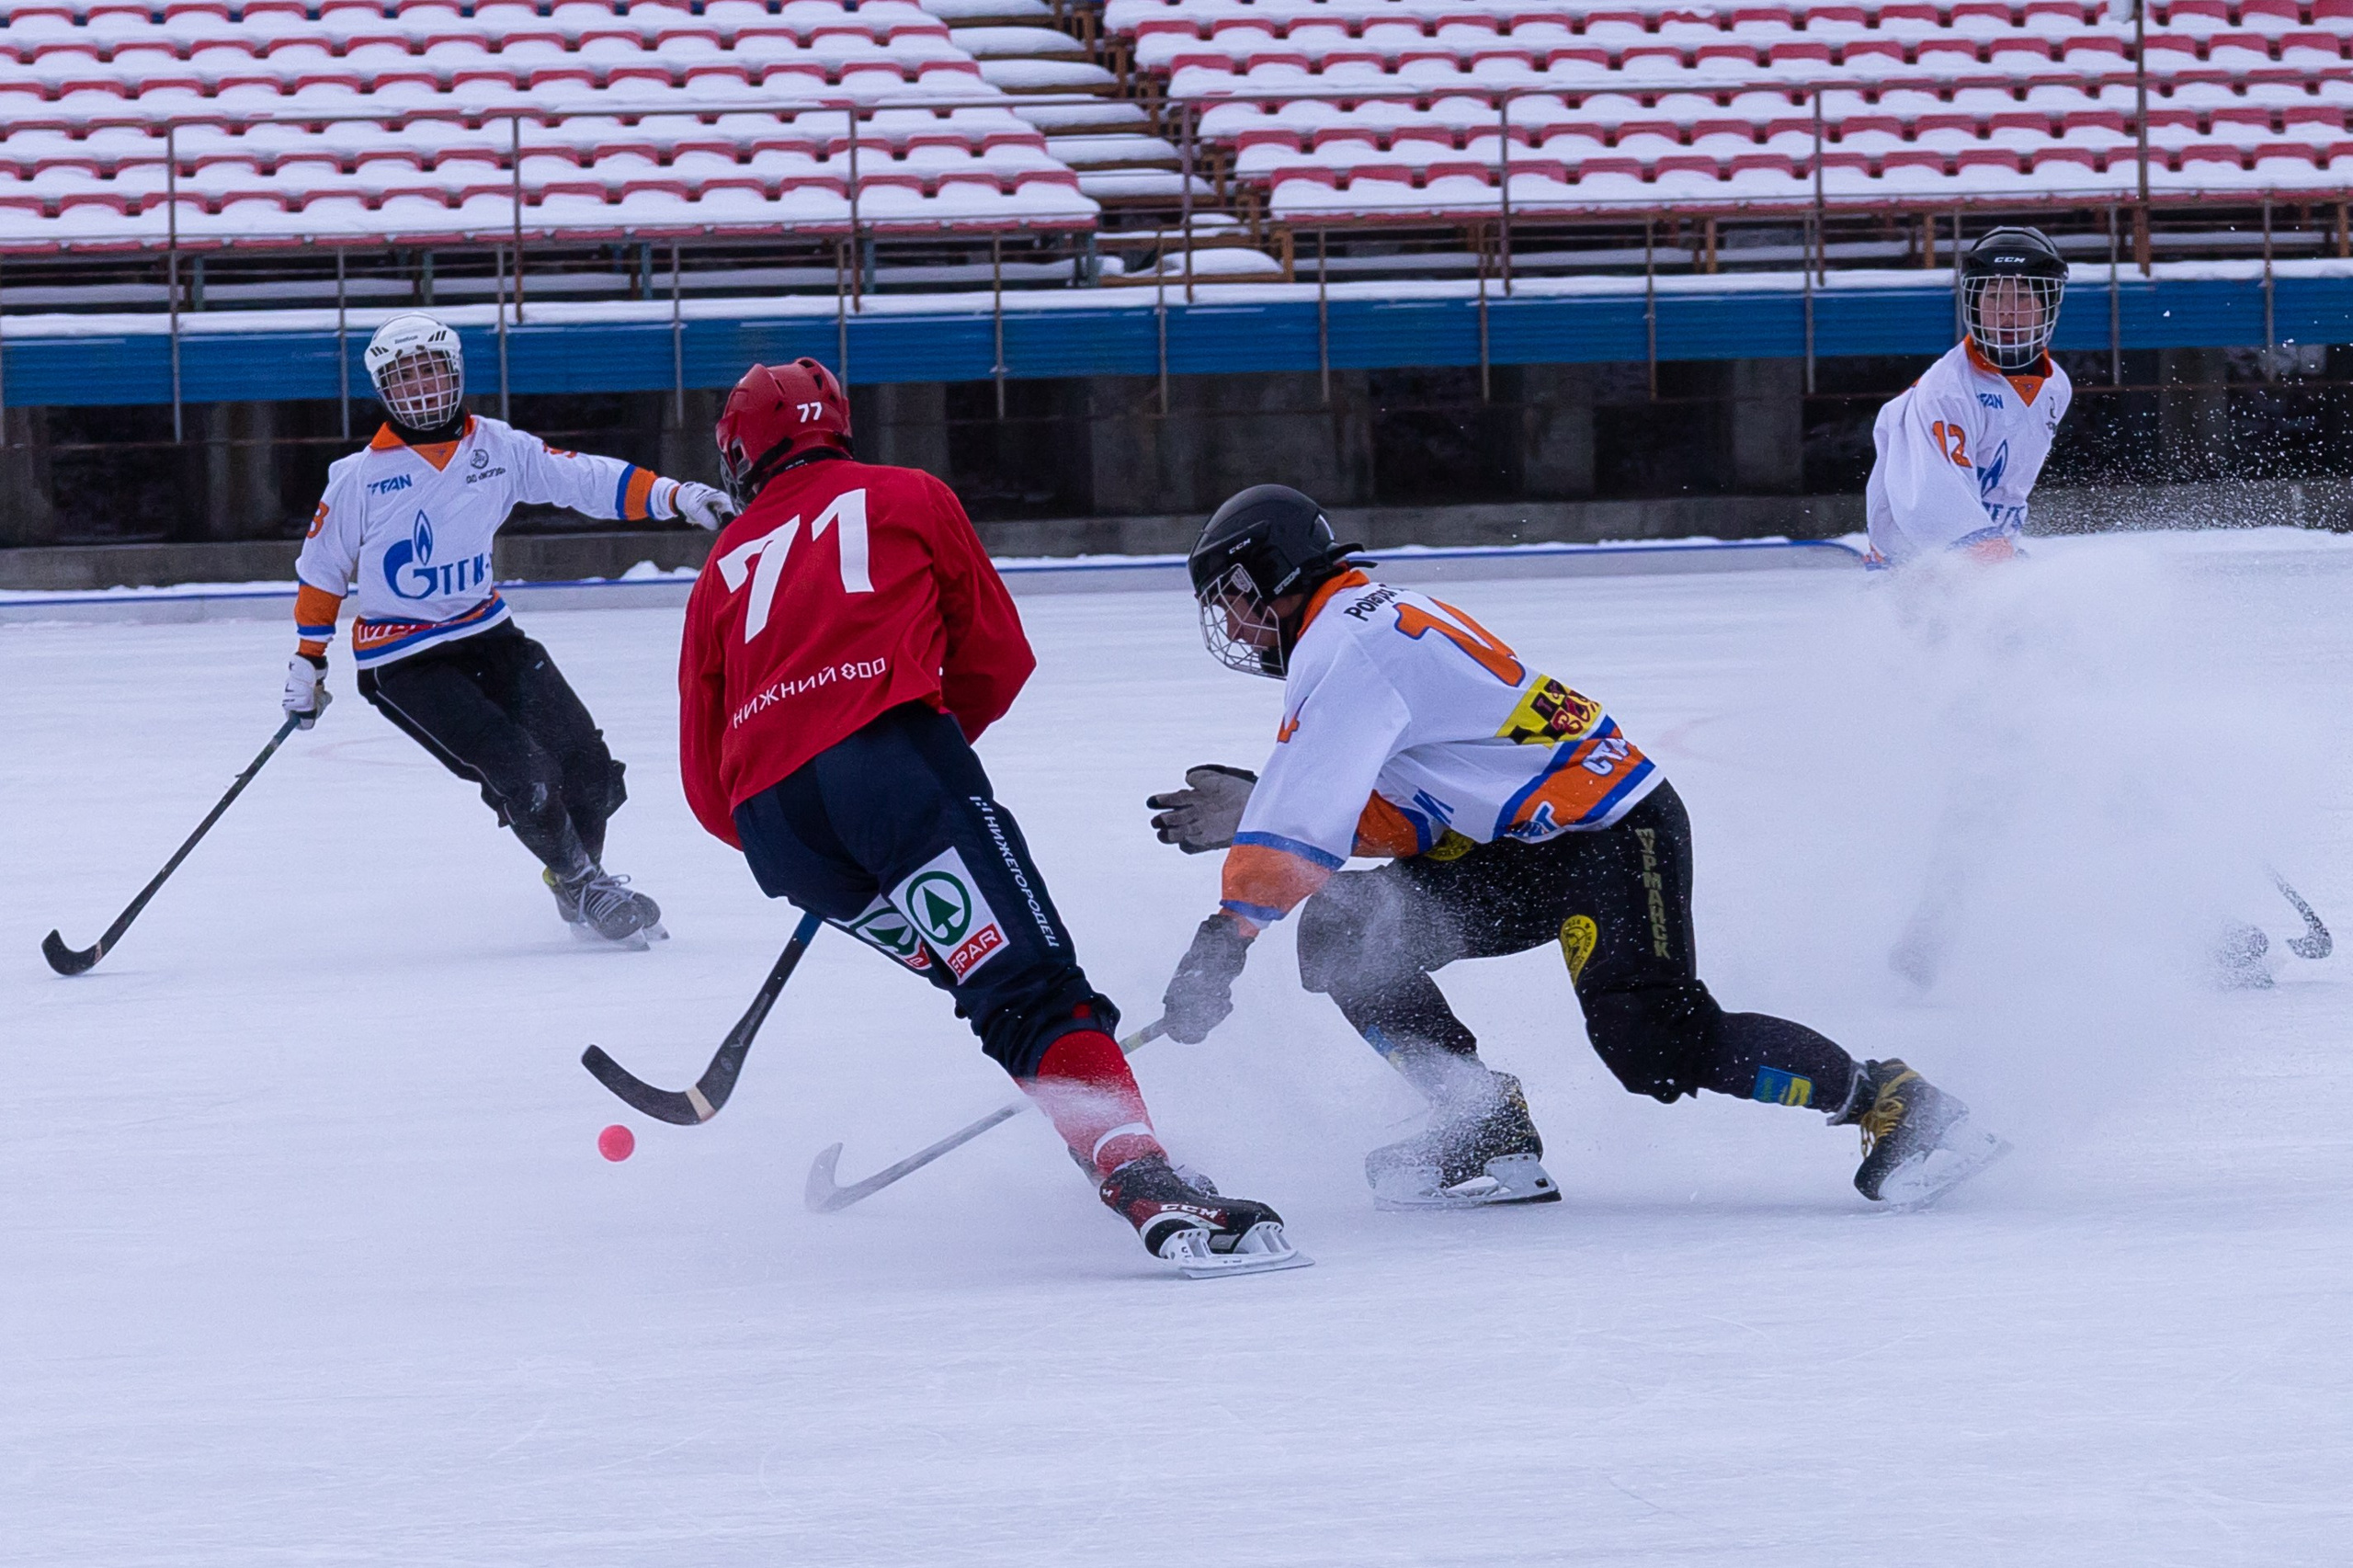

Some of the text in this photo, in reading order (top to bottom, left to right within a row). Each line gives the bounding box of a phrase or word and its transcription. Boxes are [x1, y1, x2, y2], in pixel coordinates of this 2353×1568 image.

[797, 402, 823, 423] 77
[1932, 420, 1973, 469] 12
[716, 488, 875, 644] 71
[733, 657, 887, 729] НИЖНИЙ 800
[983, 815, 1060, 948] НИЖЕГОРОДЕЦ
[1160, 1203, 1222, 1220] CCM
